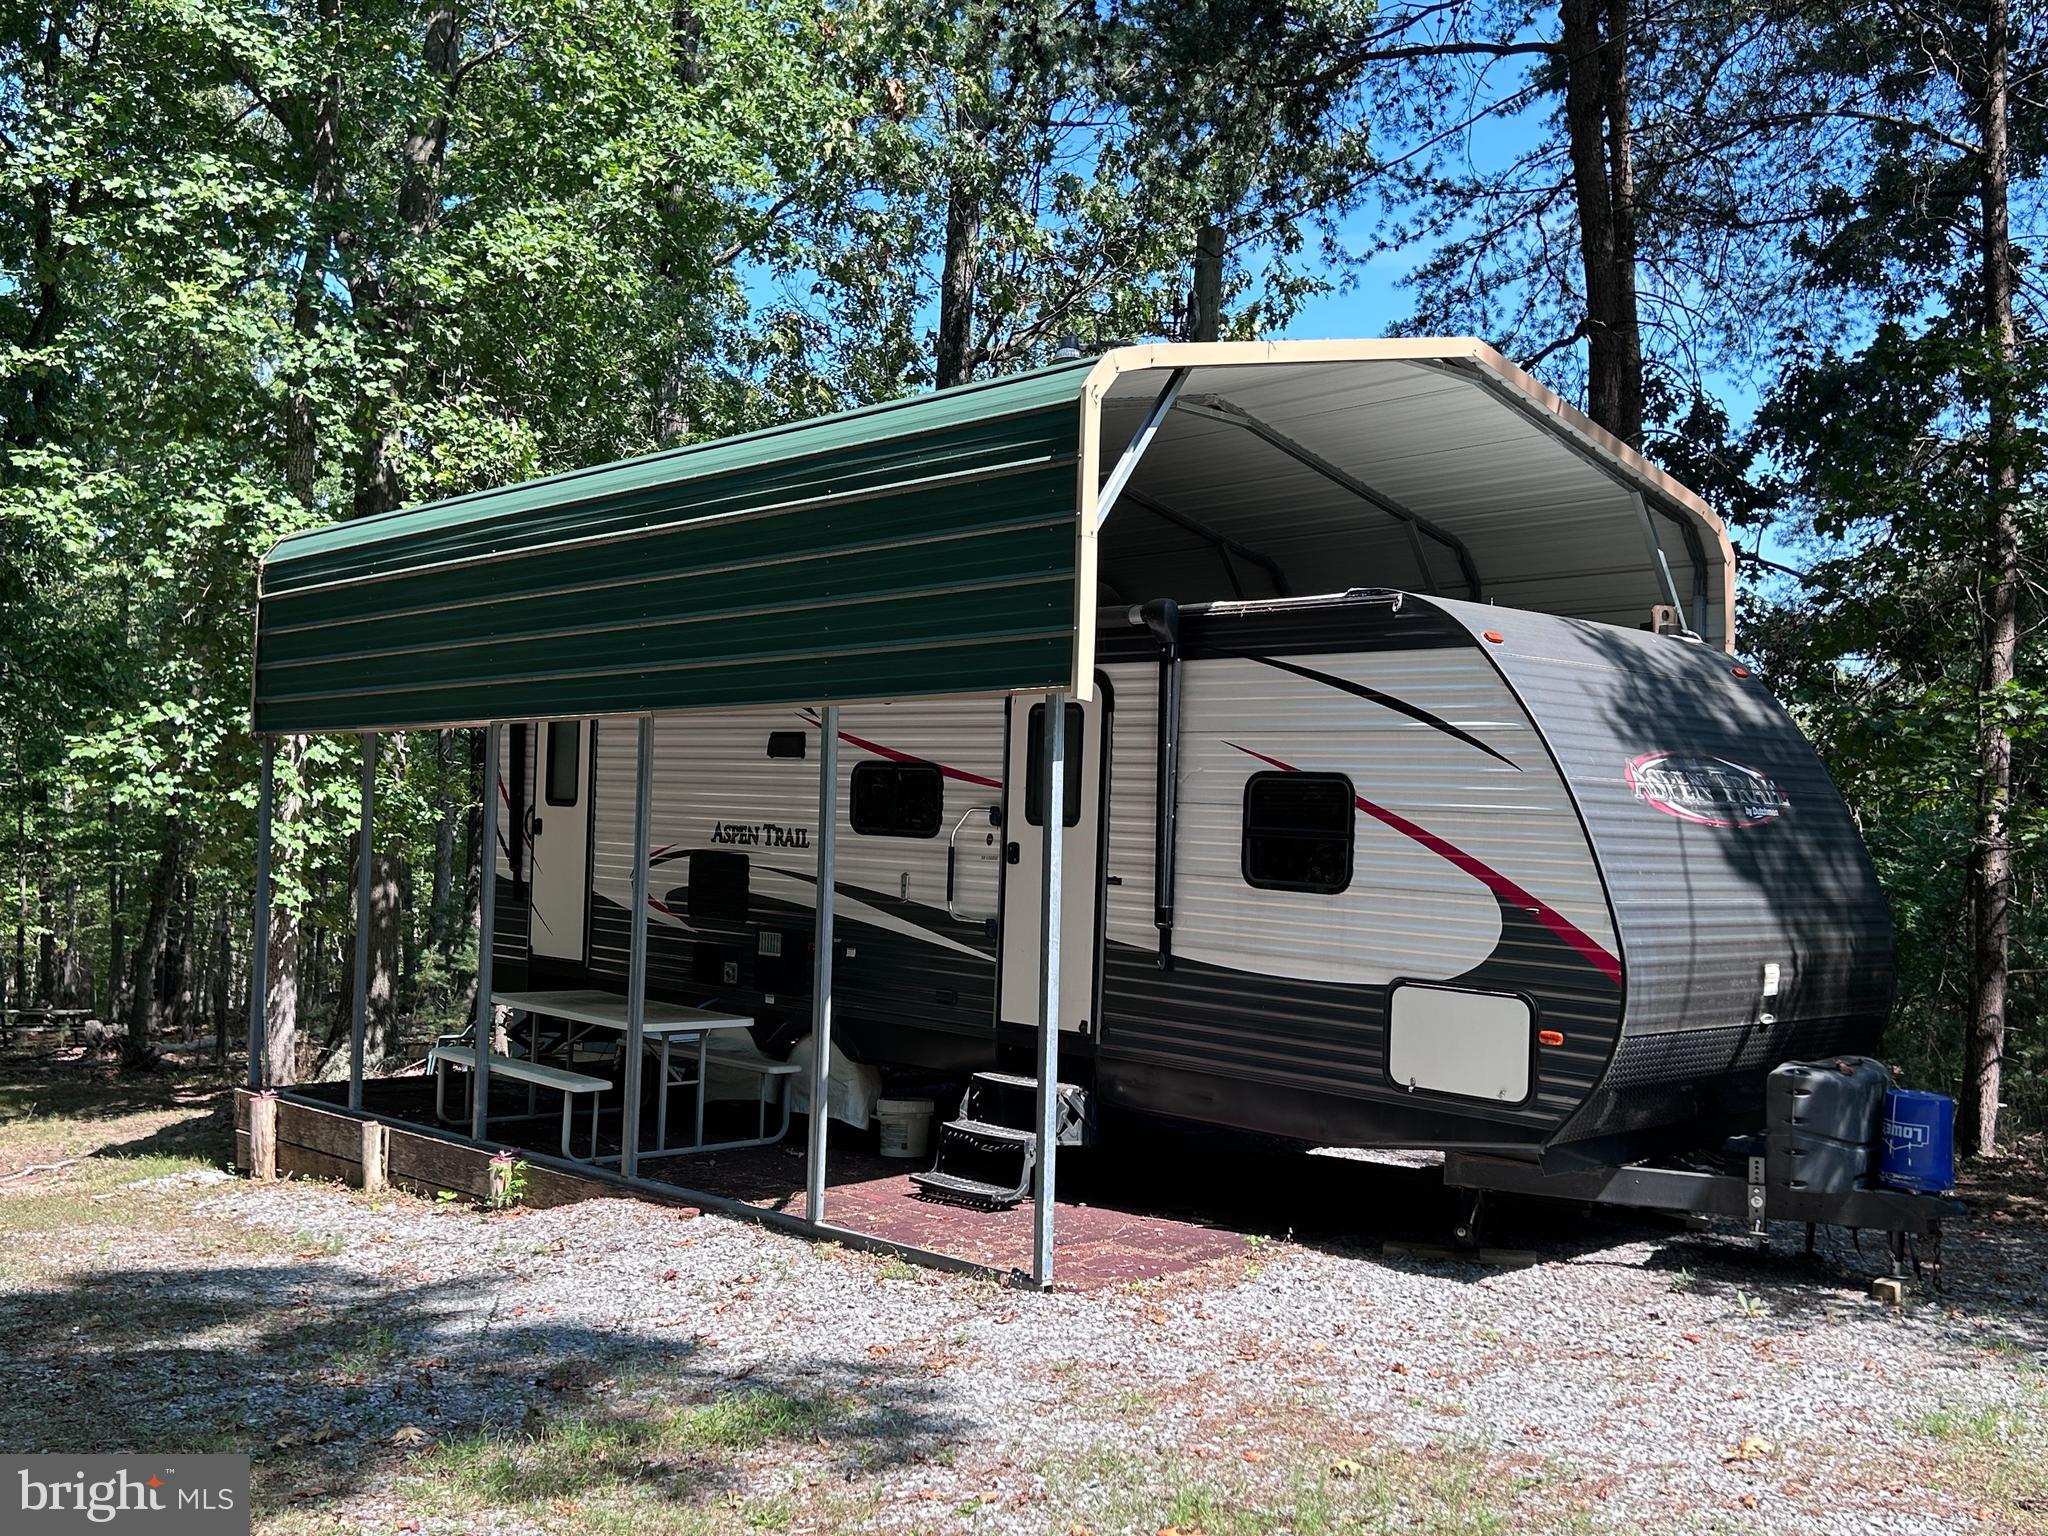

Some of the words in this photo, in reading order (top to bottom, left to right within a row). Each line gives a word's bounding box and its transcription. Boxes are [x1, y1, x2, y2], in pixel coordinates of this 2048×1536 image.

[1628, 761, 1714, 803] ASPEN
[1706, 767, 1791, 807] TRAIL
[711, 820, 760, 845] ASPEN
[763, 824, 810, 848] TRAIL
